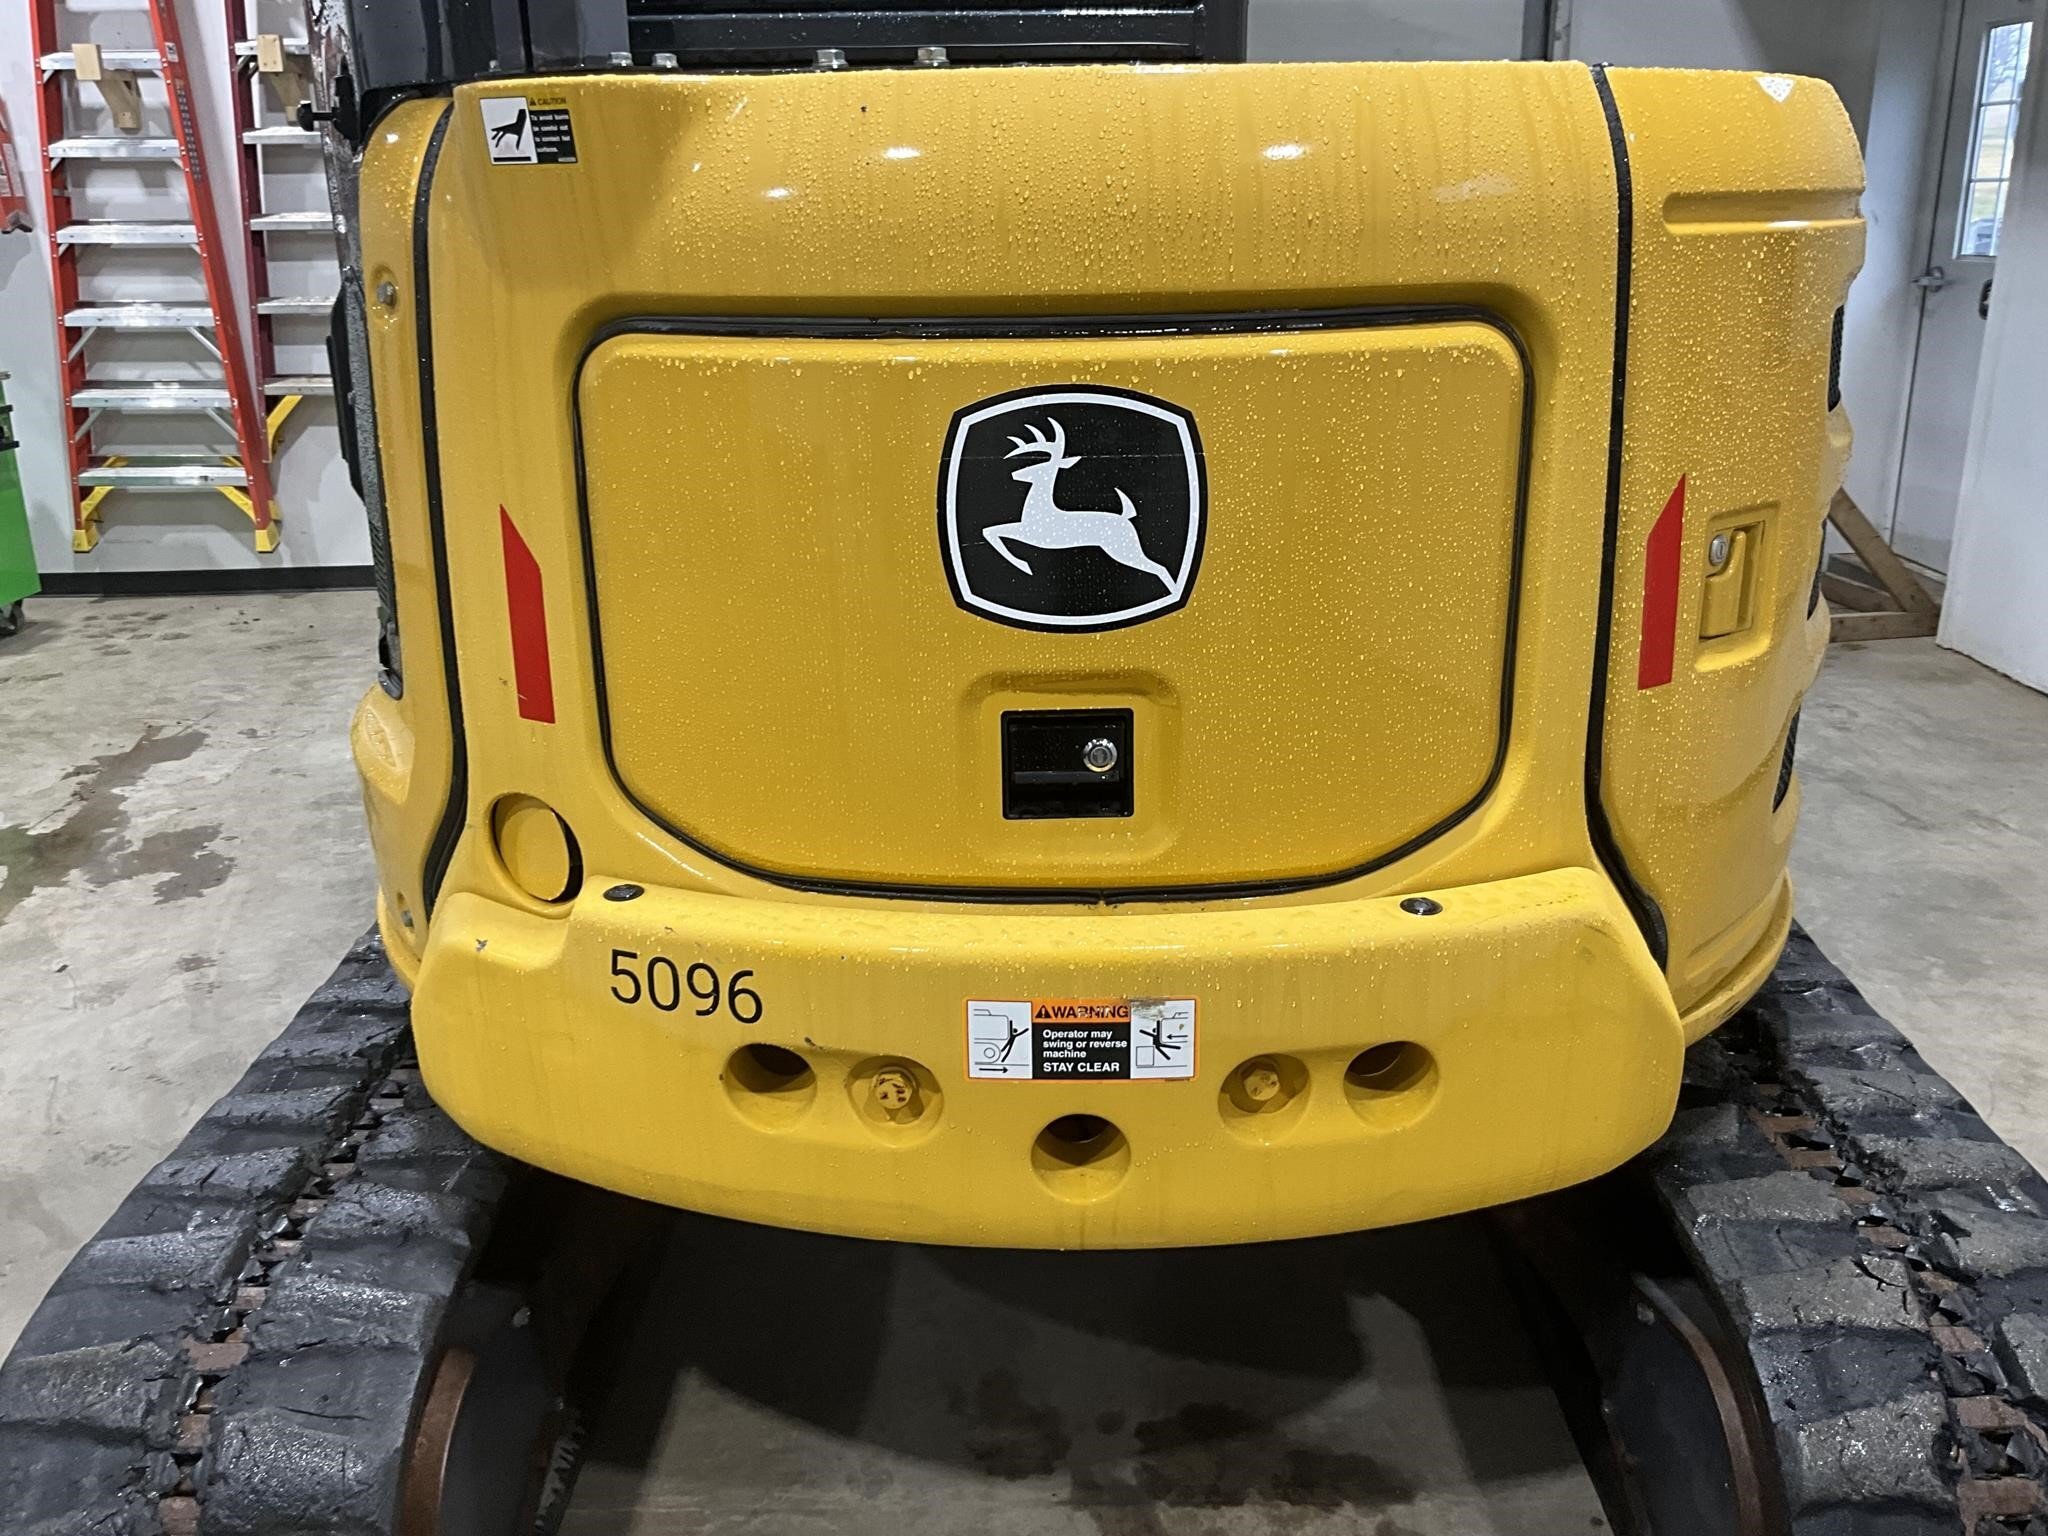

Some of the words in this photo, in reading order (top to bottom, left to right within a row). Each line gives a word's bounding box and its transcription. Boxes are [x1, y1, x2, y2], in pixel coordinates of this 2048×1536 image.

[610, 948, 763, 1024] 5096
[1051, 1005, 1129, 1019] WARNING
[1043, 1029, 1089, 1040] Operator
[1090, 1030, 1113, 1040] may
[1043, 1039, 1074, 1050] swing
[1075, 1040, 1088, 1048] or
[1089, 1040, 1128, 1048] reverse
[1043, 1049, 1087, 1058] machine
[1043, 1062, 1075, 1072] STAY
[1077, 1062, 1121, 1072] CLEAR
